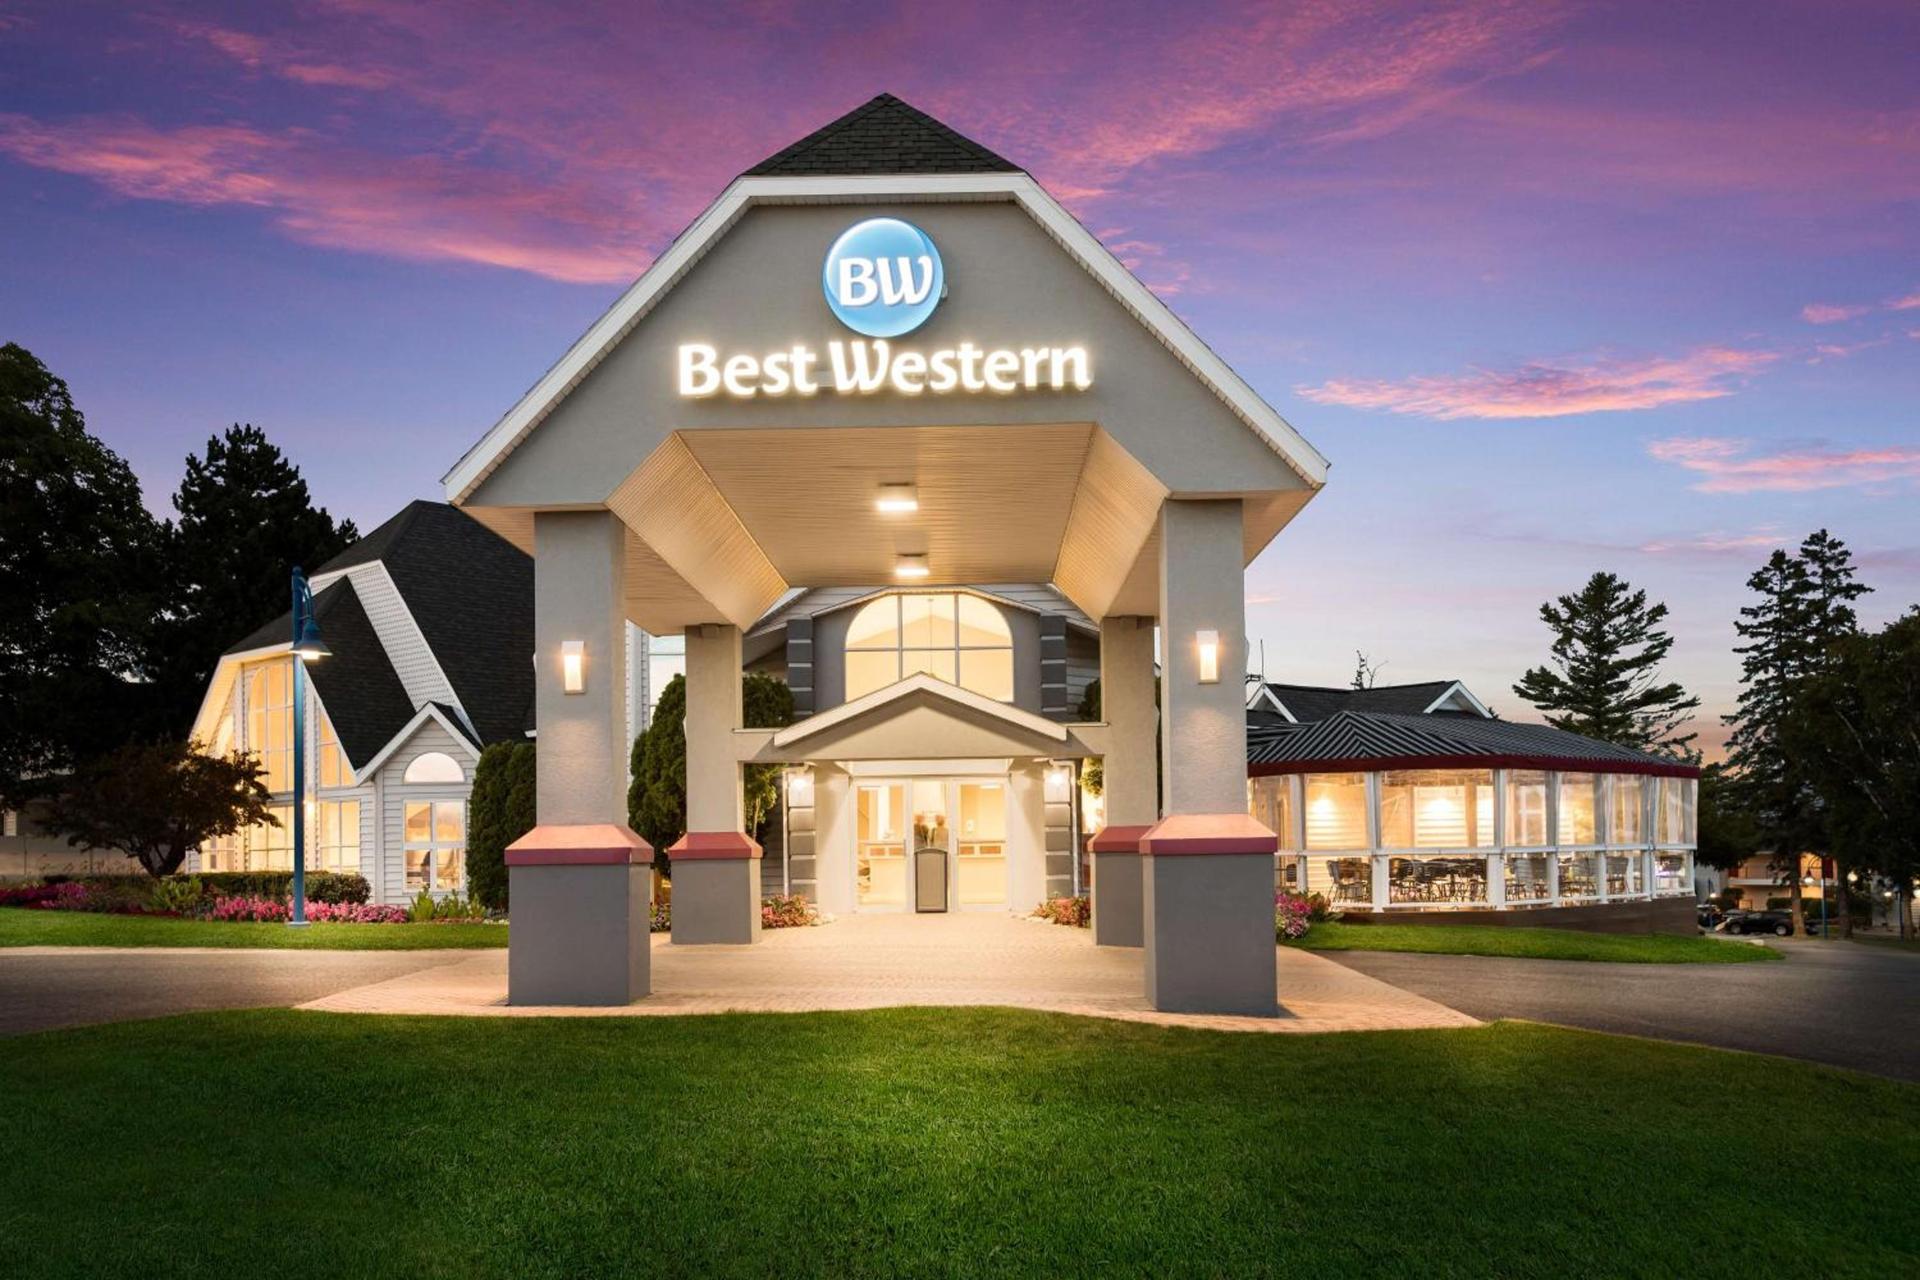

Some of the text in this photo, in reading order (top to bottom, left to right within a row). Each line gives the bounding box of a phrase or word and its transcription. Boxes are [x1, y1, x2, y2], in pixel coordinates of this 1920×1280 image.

[838, 255, 933, 306] BW
[678, 339, 1092, 397] Best Western
